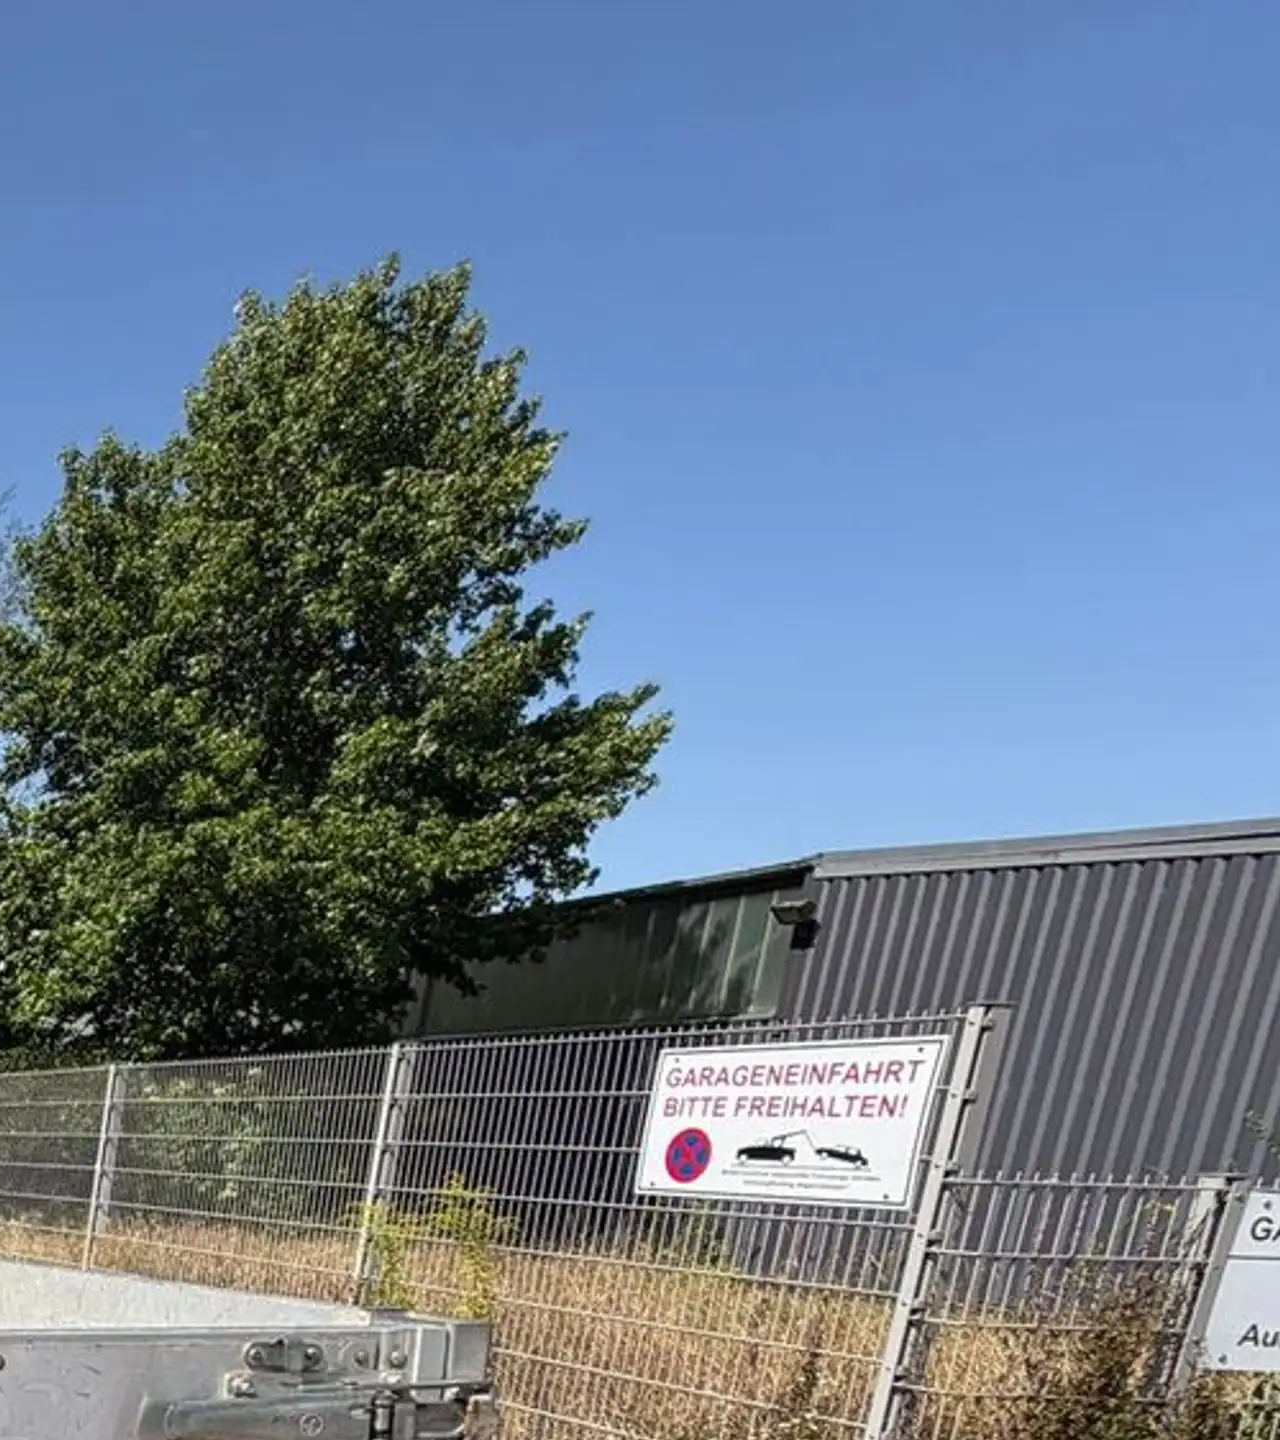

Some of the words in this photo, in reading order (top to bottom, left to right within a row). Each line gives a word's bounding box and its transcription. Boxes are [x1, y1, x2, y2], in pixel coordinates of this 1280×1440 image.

[665, 1060, 926, 1088] GARAGENEINFAHRT
[663, 1096, 727, 1118] BITTE
[733, 1094, 910, 1118] FREIHALTEN!
